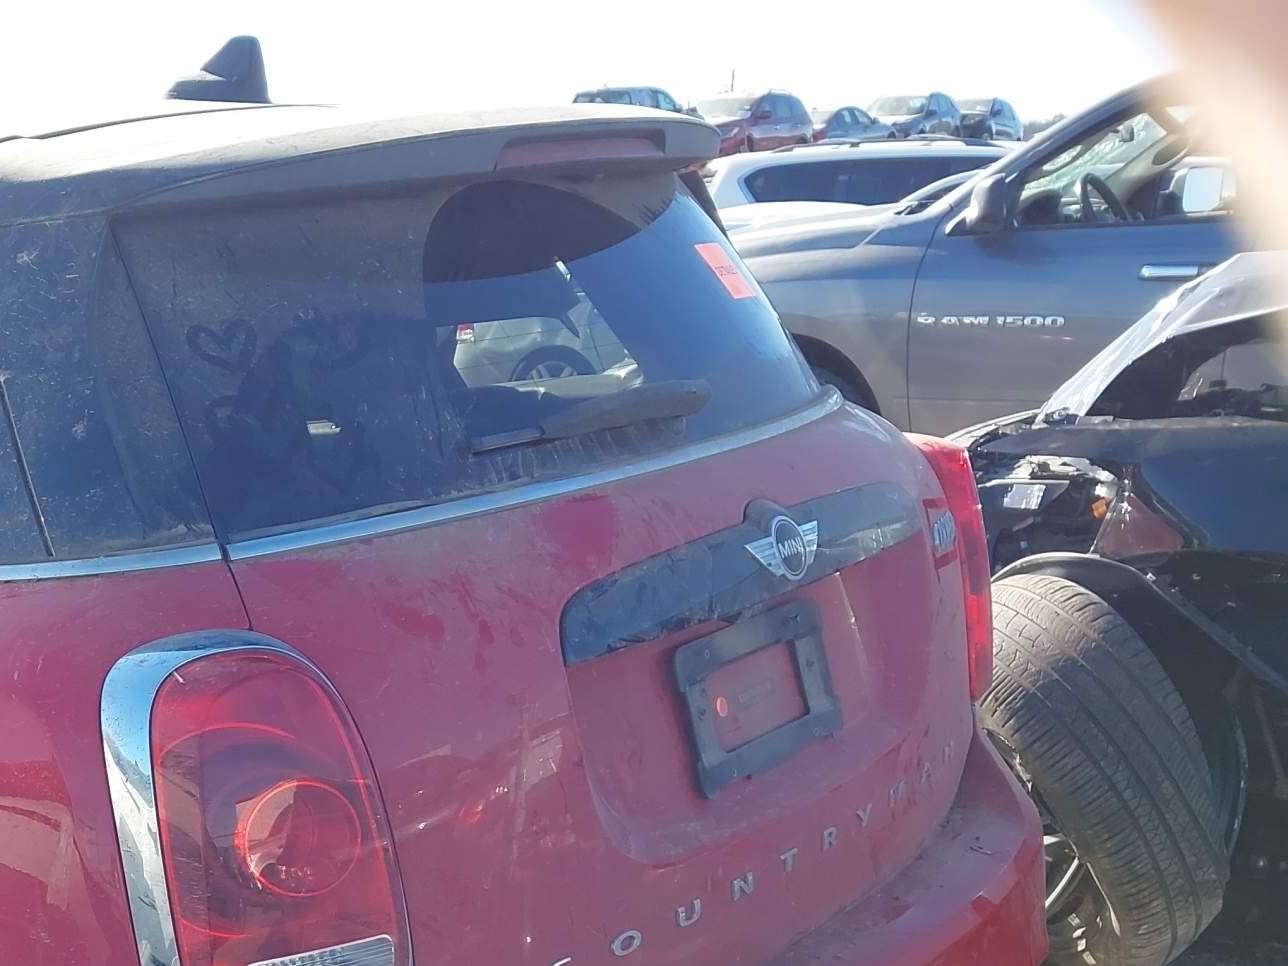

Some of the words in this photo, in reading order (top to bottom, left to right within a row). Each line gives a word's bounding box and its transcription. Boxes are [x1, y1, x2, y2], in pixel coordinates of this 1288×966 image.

[916, 312, 990, 327] RAM
[996, 315, 1065, 328] 1500
[778, 536, 805, 559] MINI
